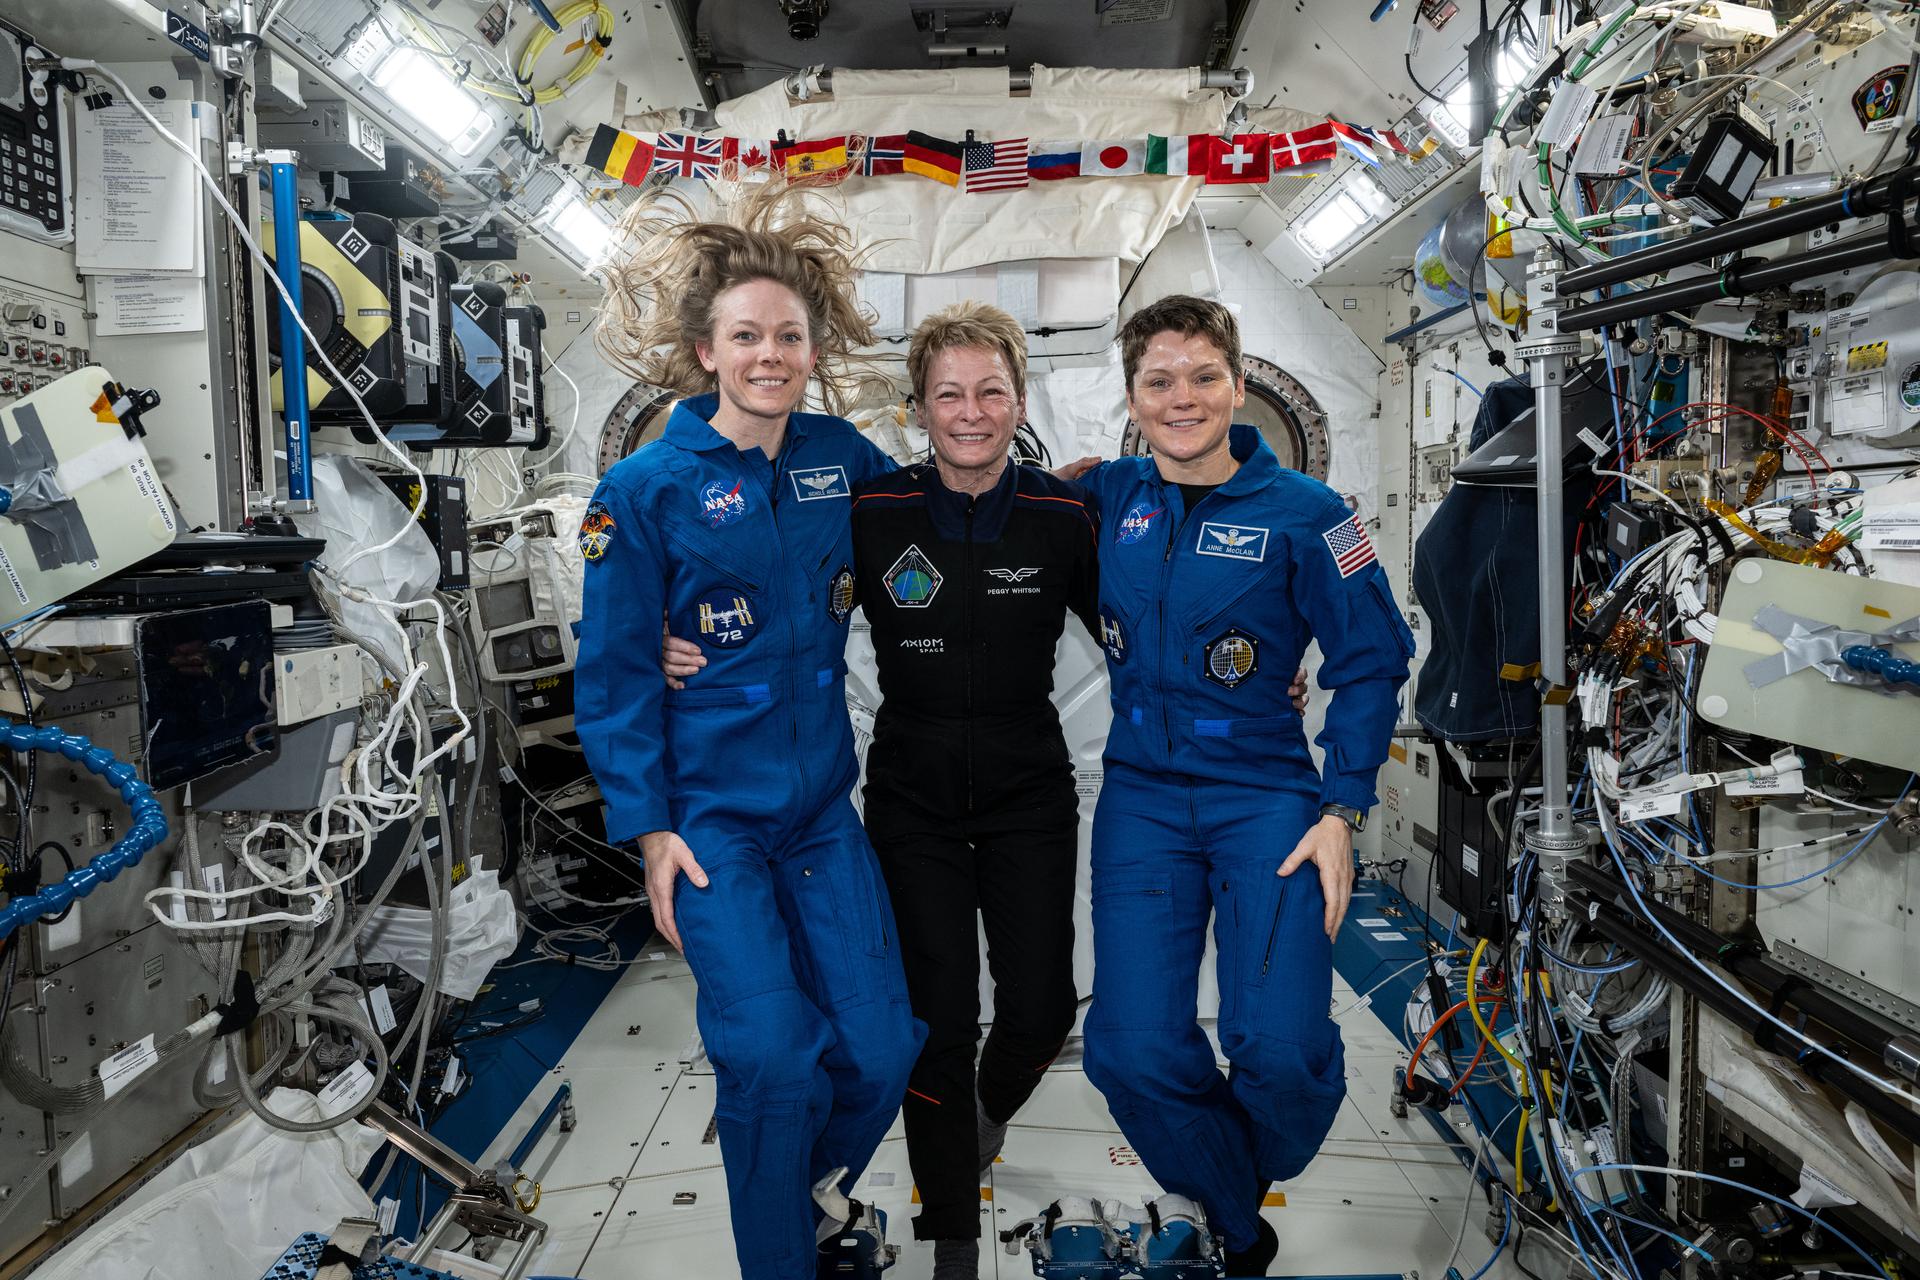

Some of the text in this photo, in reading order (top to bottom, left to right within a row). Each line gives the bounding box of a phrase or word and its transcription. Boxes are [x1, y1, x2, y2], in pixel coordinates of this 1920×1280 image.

[136, 476, 149, 496] DRUG
[142, 469, 159, 498] FACTOR
[704, 493, 744, 511] NASA
[156, 498, 174, 530] GROWTH
[1121, 518, 1149, 529] NASA
[1206, 544, 1254, 557] ANNE McCLAIN
[0, 547, 28, 603] GROWTH FACTO
[716, 629, 744, 644] 72
[900, 638, 944, 648] AXIOM
[1108, 645, 1121, 659] 72
